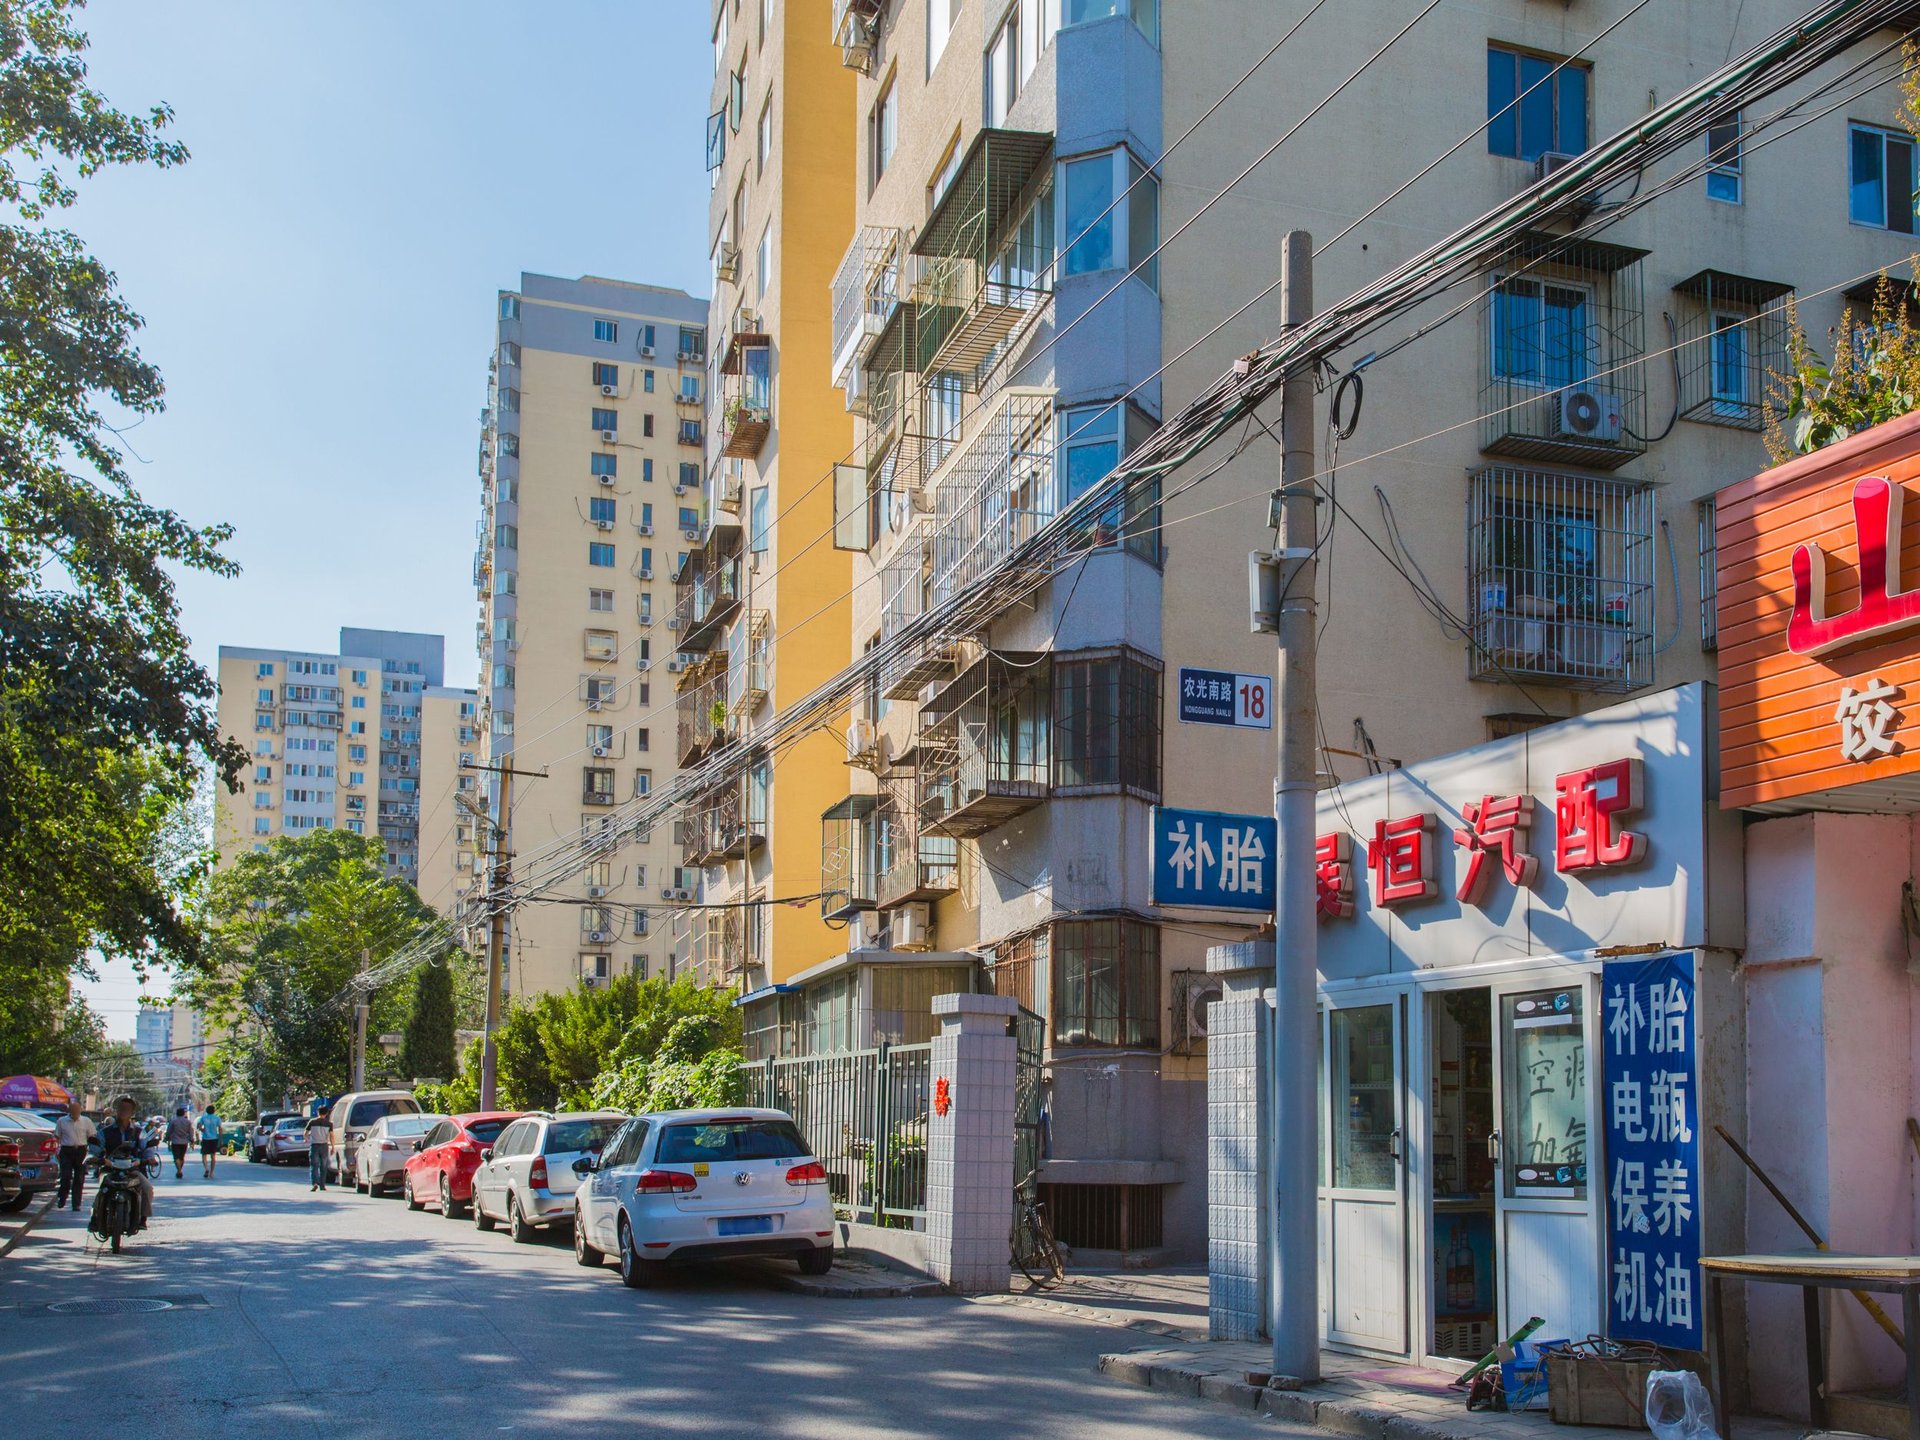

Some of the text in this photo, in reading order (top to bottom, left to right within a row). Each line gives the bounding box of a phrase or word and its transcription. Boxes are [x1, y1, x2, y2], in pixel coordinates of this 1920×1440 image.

[1184, 677, 1232, 702] 农光南路
[1185, 705, 1232, 718] NONGGUANG NANLU
[1240, 683, 1265, 719] 18
[1834, 678, 1902, 763] 饺
[1168, 820, 1266, 895] 补胎
[1609, 977, 1688, 1056] 补胎
[1613, 1069, 1692, 1145] 电瓶
[1612, 1156, 1692, 1237] 保养
[1613, 1247, 1693, 1331] 机油
